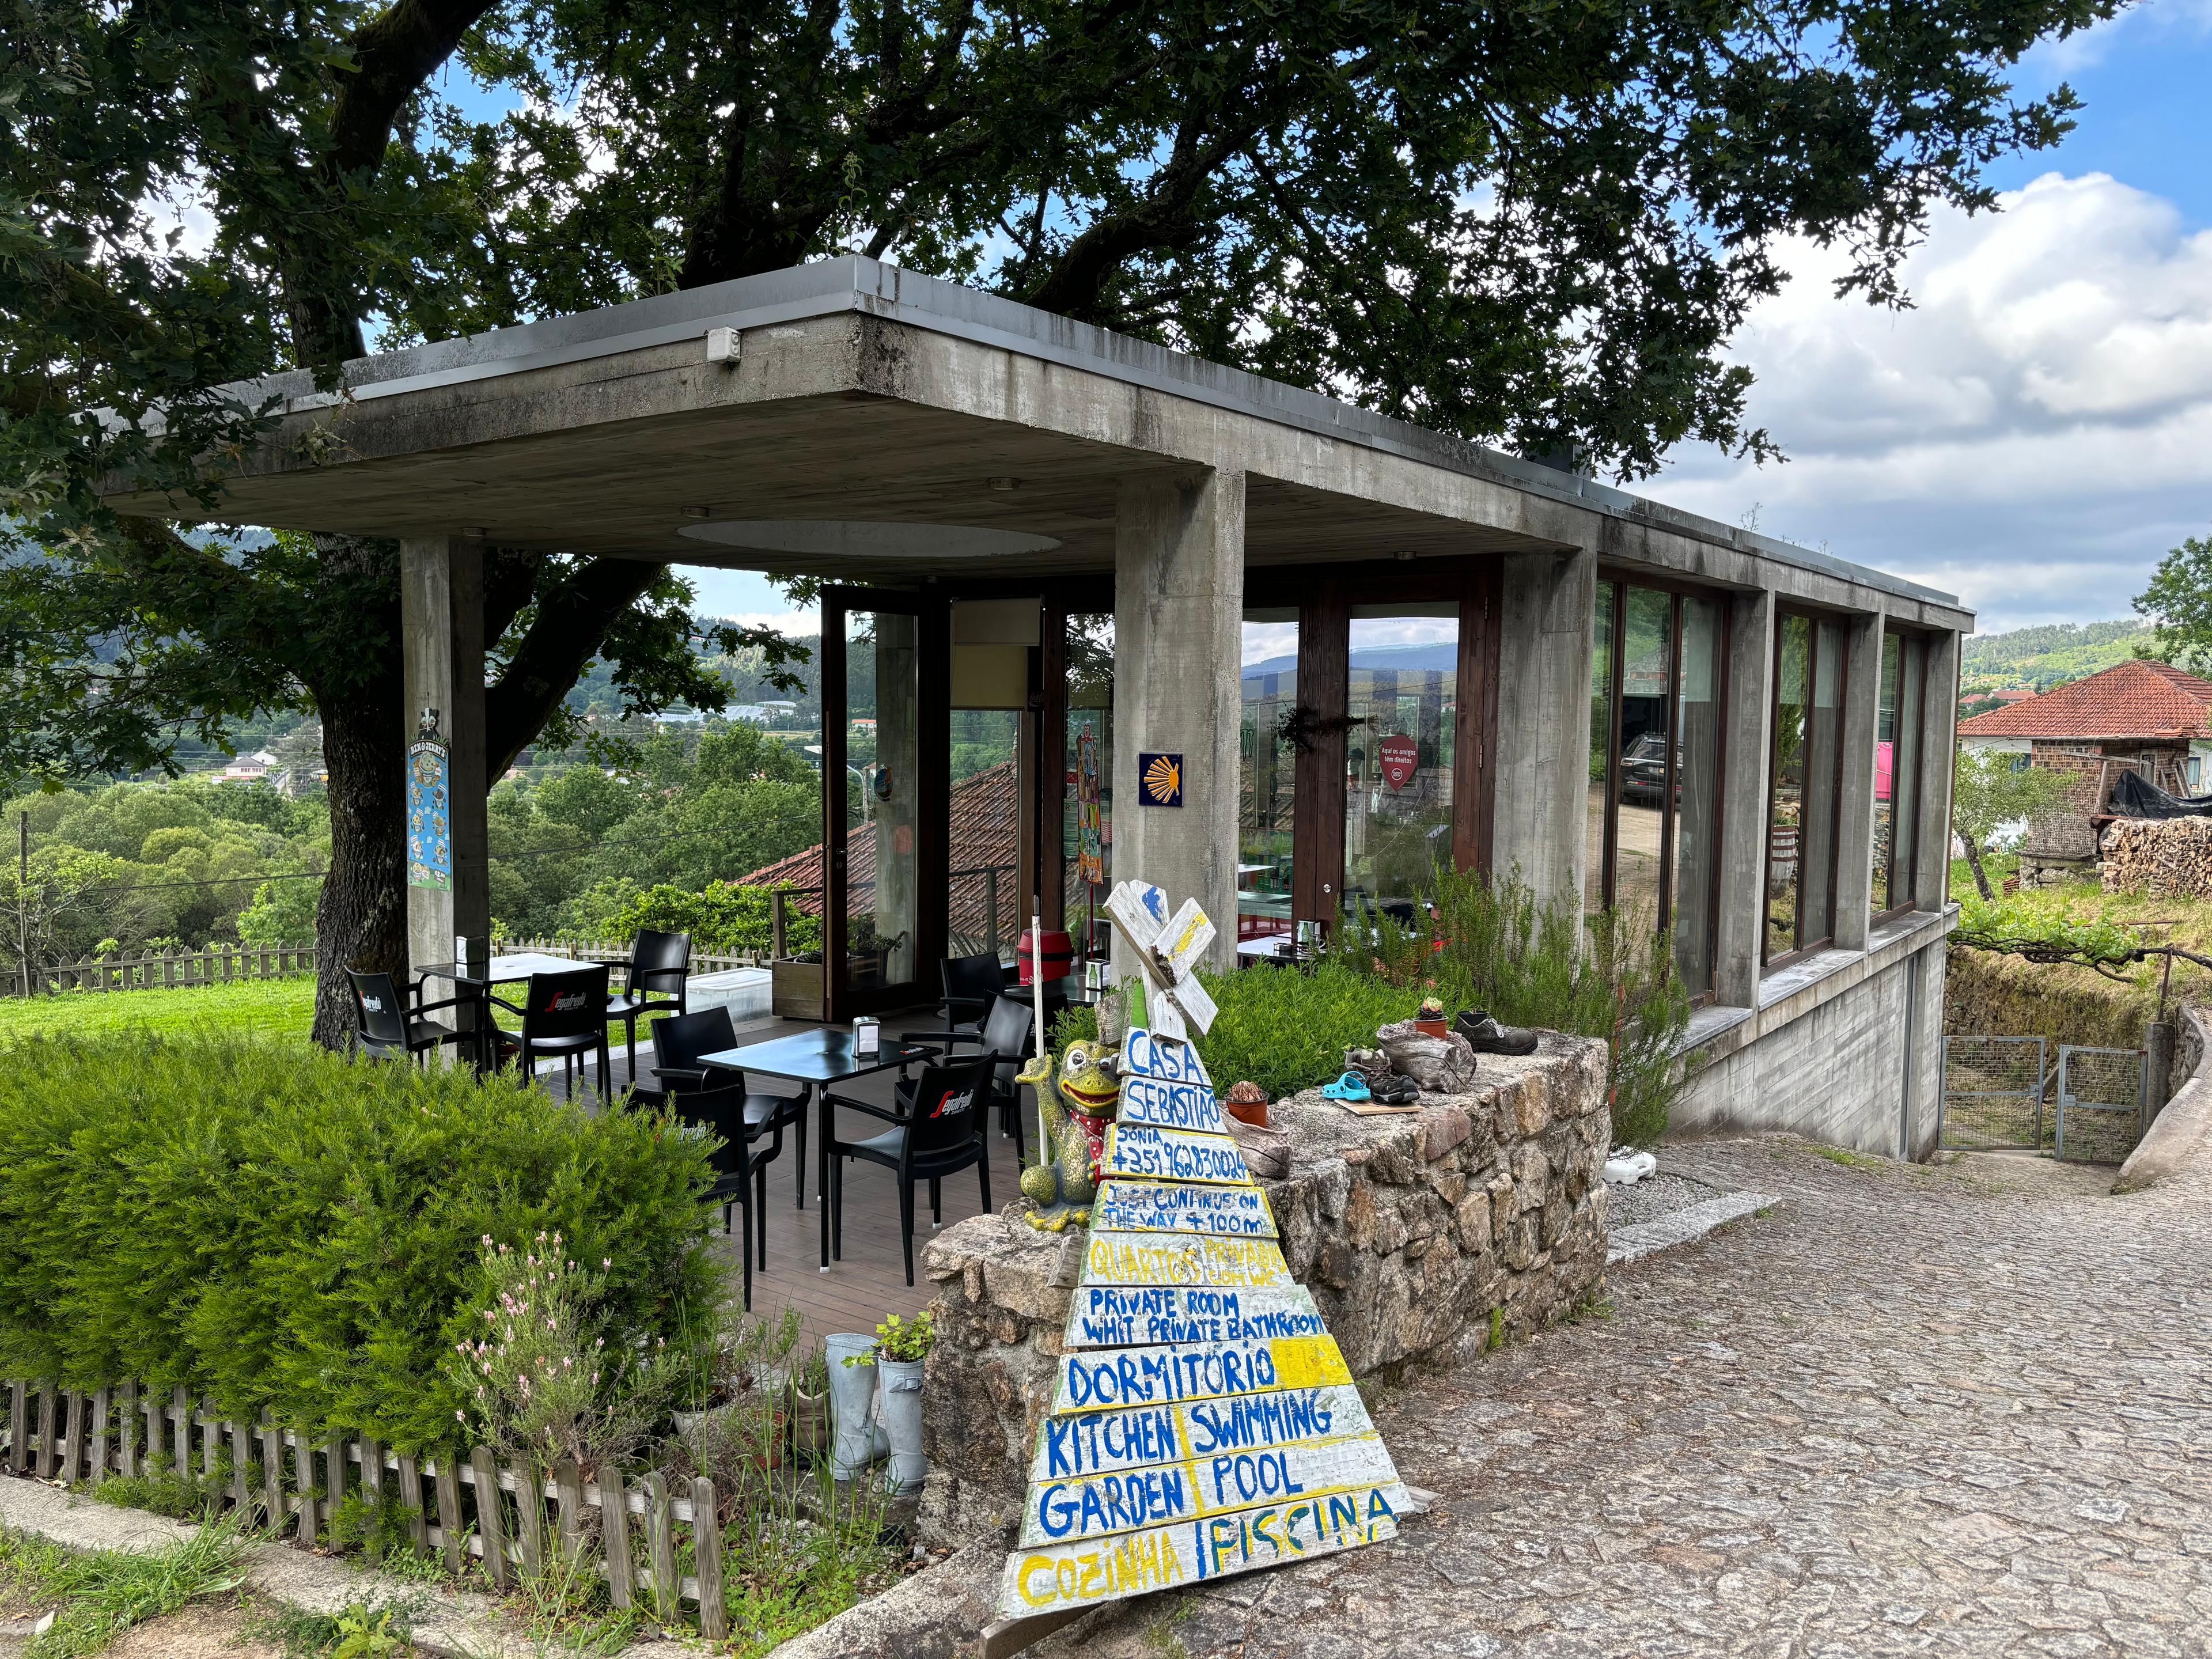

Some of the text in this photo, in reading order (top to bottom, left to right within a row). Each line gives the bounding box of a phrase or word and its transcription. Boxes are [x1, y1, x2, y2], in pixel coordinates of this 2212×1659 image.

[1128, 1031, 1203, 1084] CASA
[1104, 1207, 1136, 1229] THE
[1139, 1210, 1177, 1228] WAY
[1105, 1184, 1258, 1210] JUST CONTINUE ON
[1090, 1238, 1200, 1284] QUARTOS
[1209, 1269, 1278, 1287] COM WC
[1082, 1312, 1324, 1344] WHIT PRIVATE BATHROOM
[1090, 1289, 1240, 1319] PRIVATE ROOM
[1046, 1404, 1176, 1478] KITCHEN
[1191, 1389, 1332, 1452] SWIMMING
[1039, 1468, 1184, 1537] GARDEN
[1214, 1450, 1304, 1505] POOL
[1210, 1488, 1399, 1574] PISCINA
[1017, 1531, 1185, 1608] COZINHA
